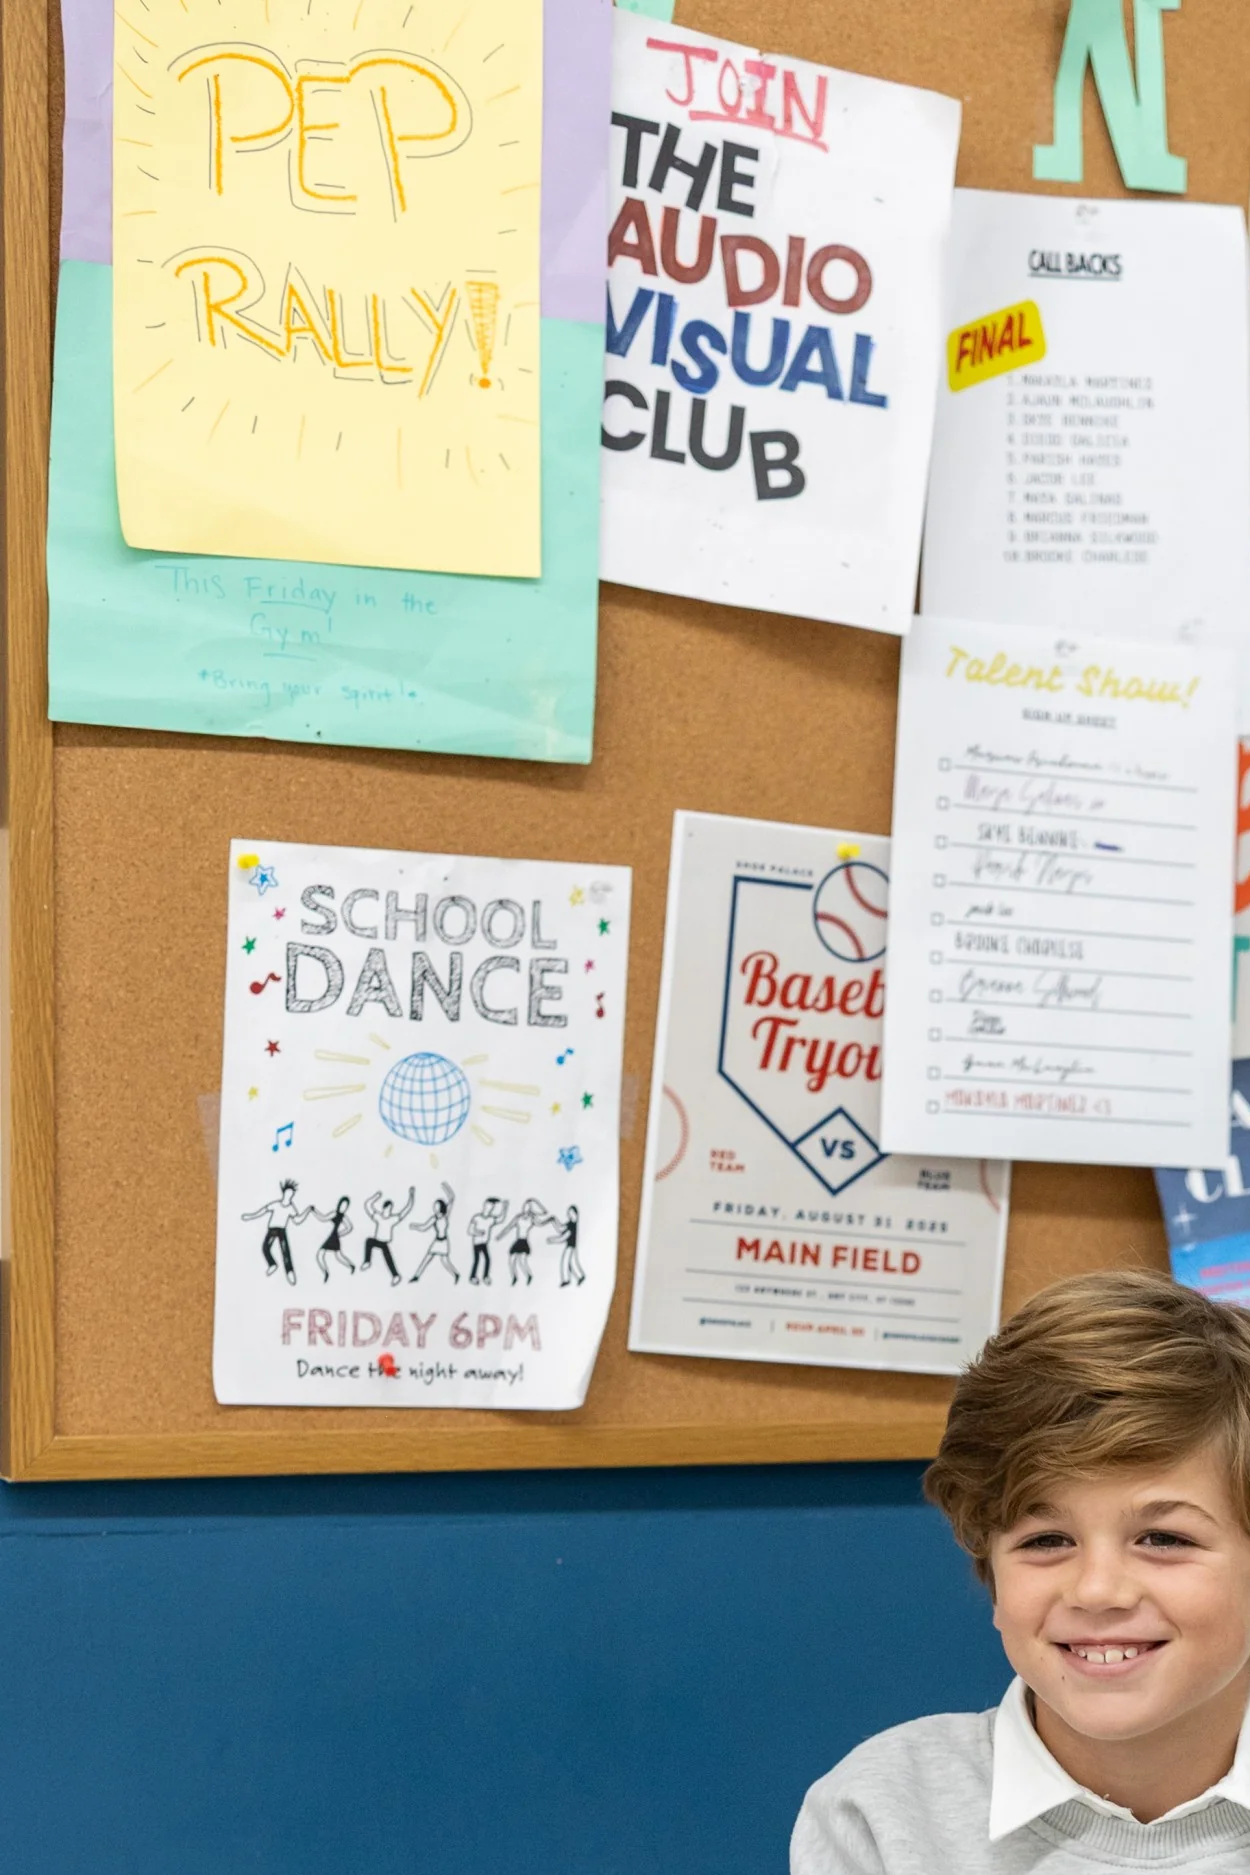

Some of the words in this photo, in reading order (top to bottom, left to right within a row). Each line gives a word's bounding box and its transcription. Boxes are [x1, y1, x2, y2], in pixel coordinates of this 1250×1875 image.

[647, 38, 828, 140] JOIN
[168, 42, 472, 222] PEP
[611, 111, 759, 217] THE
[608, 197, 872, 315] AUDIO
[162, 246, 502, 399] RALLY!
[606, 280, 888, 410] VISUAL
[956, 310, 1034, 375] FINAL
[600, 380, 806, 501] CLUB
[155, 565, 226, 599] This
[243, 575, 336, 614] Friday
[355, 593, 377, 607] in
[402, 592, 438, 615] the
[946, 645, 1064, 693] Talent
[300, 884, 557, 950] SCHOOL
[285, 942, 569, 1028] DANCE
[740, 951, 885, 1019] Baseb
[820, 1137, 856, 1160] VS
[795, 1208, 866, 1226] AUGUST
[735, 1237, 822, 1267] MAIN
[831, 1245, 922, 1275] FIELD
[281, 1308, 436, 1350] FRIDAY
[448, 1311, 542, 1352] 6PM
[297, 1359, 360, 1379] Dance
[368, 1358, 401, 1379] te
[409, 1361, 457, 1384] night
[464, 1363, 524, 1384] away!
